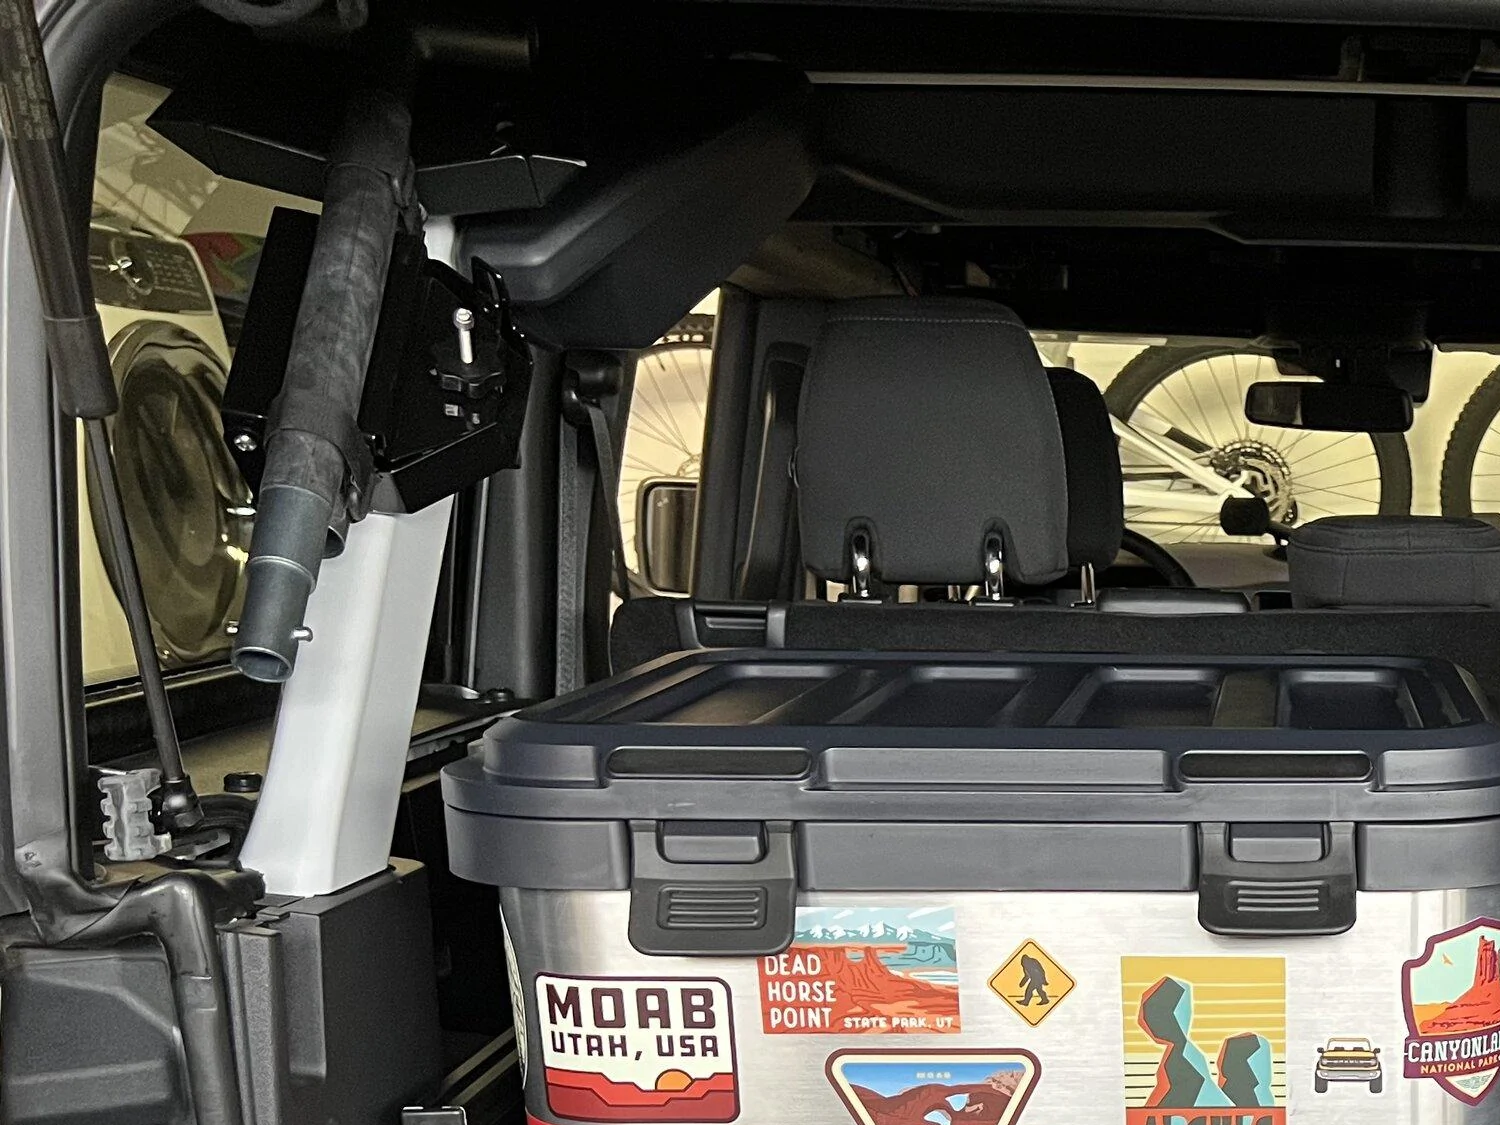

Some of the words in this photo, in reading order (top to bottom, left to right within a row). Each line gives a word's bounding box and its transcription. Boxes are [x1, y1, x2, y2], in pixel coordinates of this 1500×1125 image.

[765, 954, 821, 976] DEAD
[767, 981, 836, 1003] HORSE
[546, 983, 716, 1029] MOAB
[770, 1007, 832, 1029] POINT
[844, 1017, 887, 1028] STATE
[936, 1017, 953, 1028] UT
[551, 1030, 642, 1061] UTAH,
[656, 1035, 719, 1057] USA
[1421, 1061, 1475, 1074] NATIONAL
[1479, 1055, 1497, 1067] PARK
